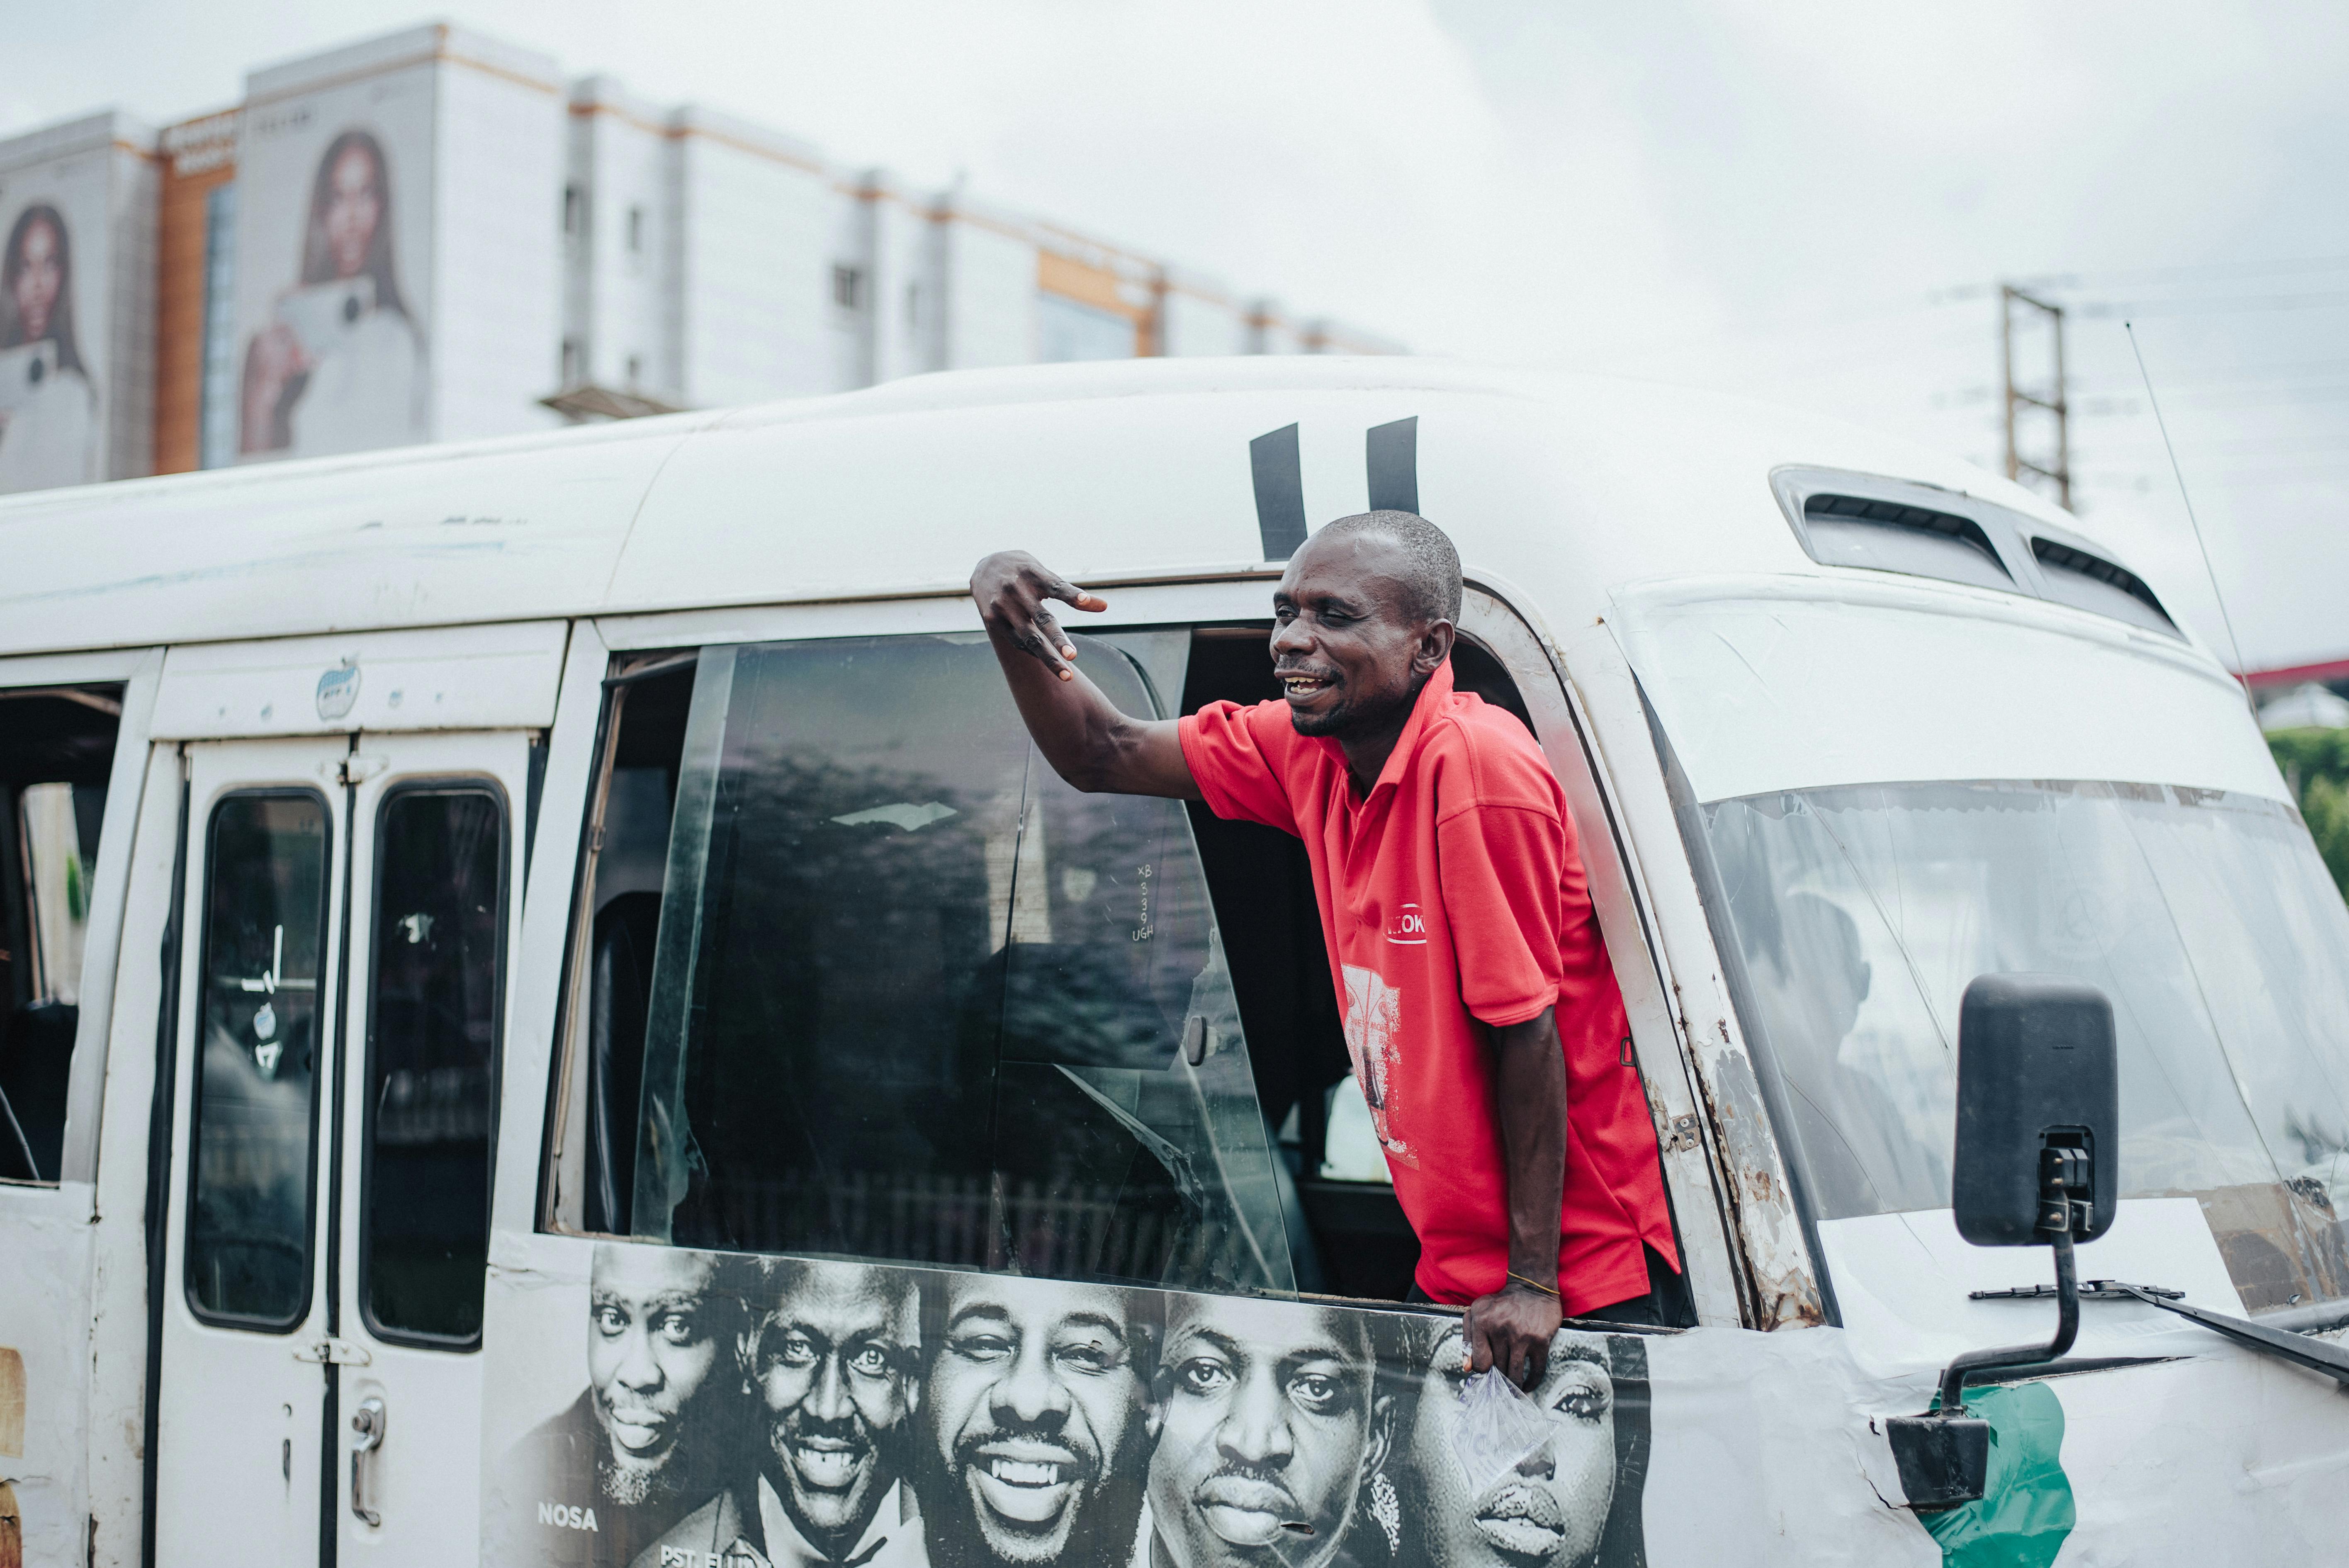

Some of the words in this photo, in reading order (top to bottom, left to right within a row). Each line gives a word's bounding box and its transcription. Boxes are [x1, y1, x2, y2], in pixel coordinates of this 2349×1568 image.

[1138, 864, 1152, 878] XB
[1133, 925, 1153, 941] UGH
[537, 1501, 599, 1532] NOSA
